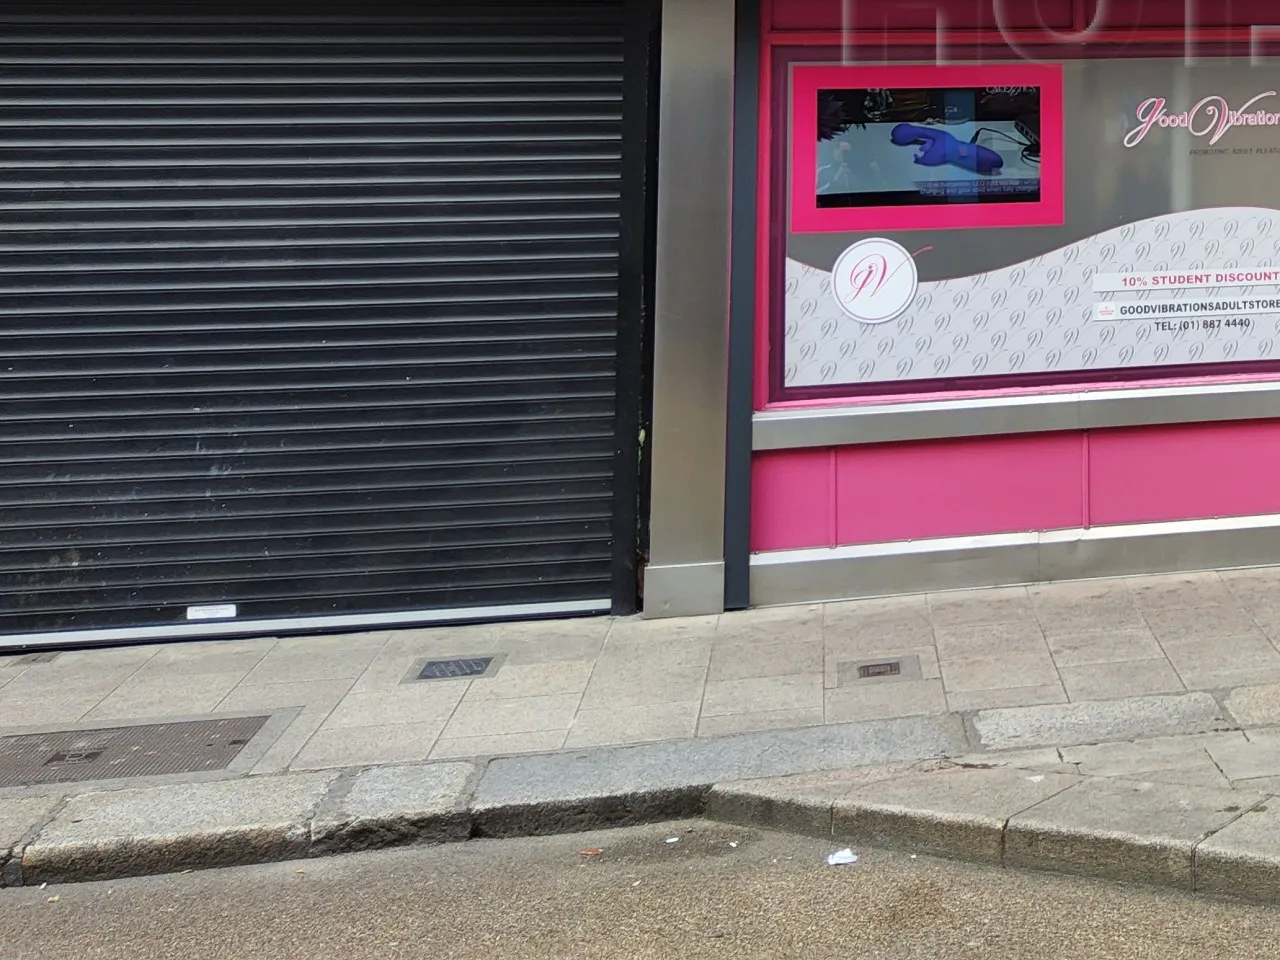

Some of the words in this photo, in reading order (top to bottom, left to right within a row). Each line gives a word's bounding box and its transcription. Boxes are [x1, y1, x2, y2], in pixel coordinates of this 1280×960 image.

[1121, 275, 1148, 287] 10%
[1152, 273, 1212, 286] STUDENT
[1215, 271, 1280, 283] DISCOUNT
[1154, 320, 1177, 332] TEL:
[1178, 319, 1200, 332] (01)
[1202, 318, 1221, 329] 887
[1224, 318, 1251, 328] 4440
